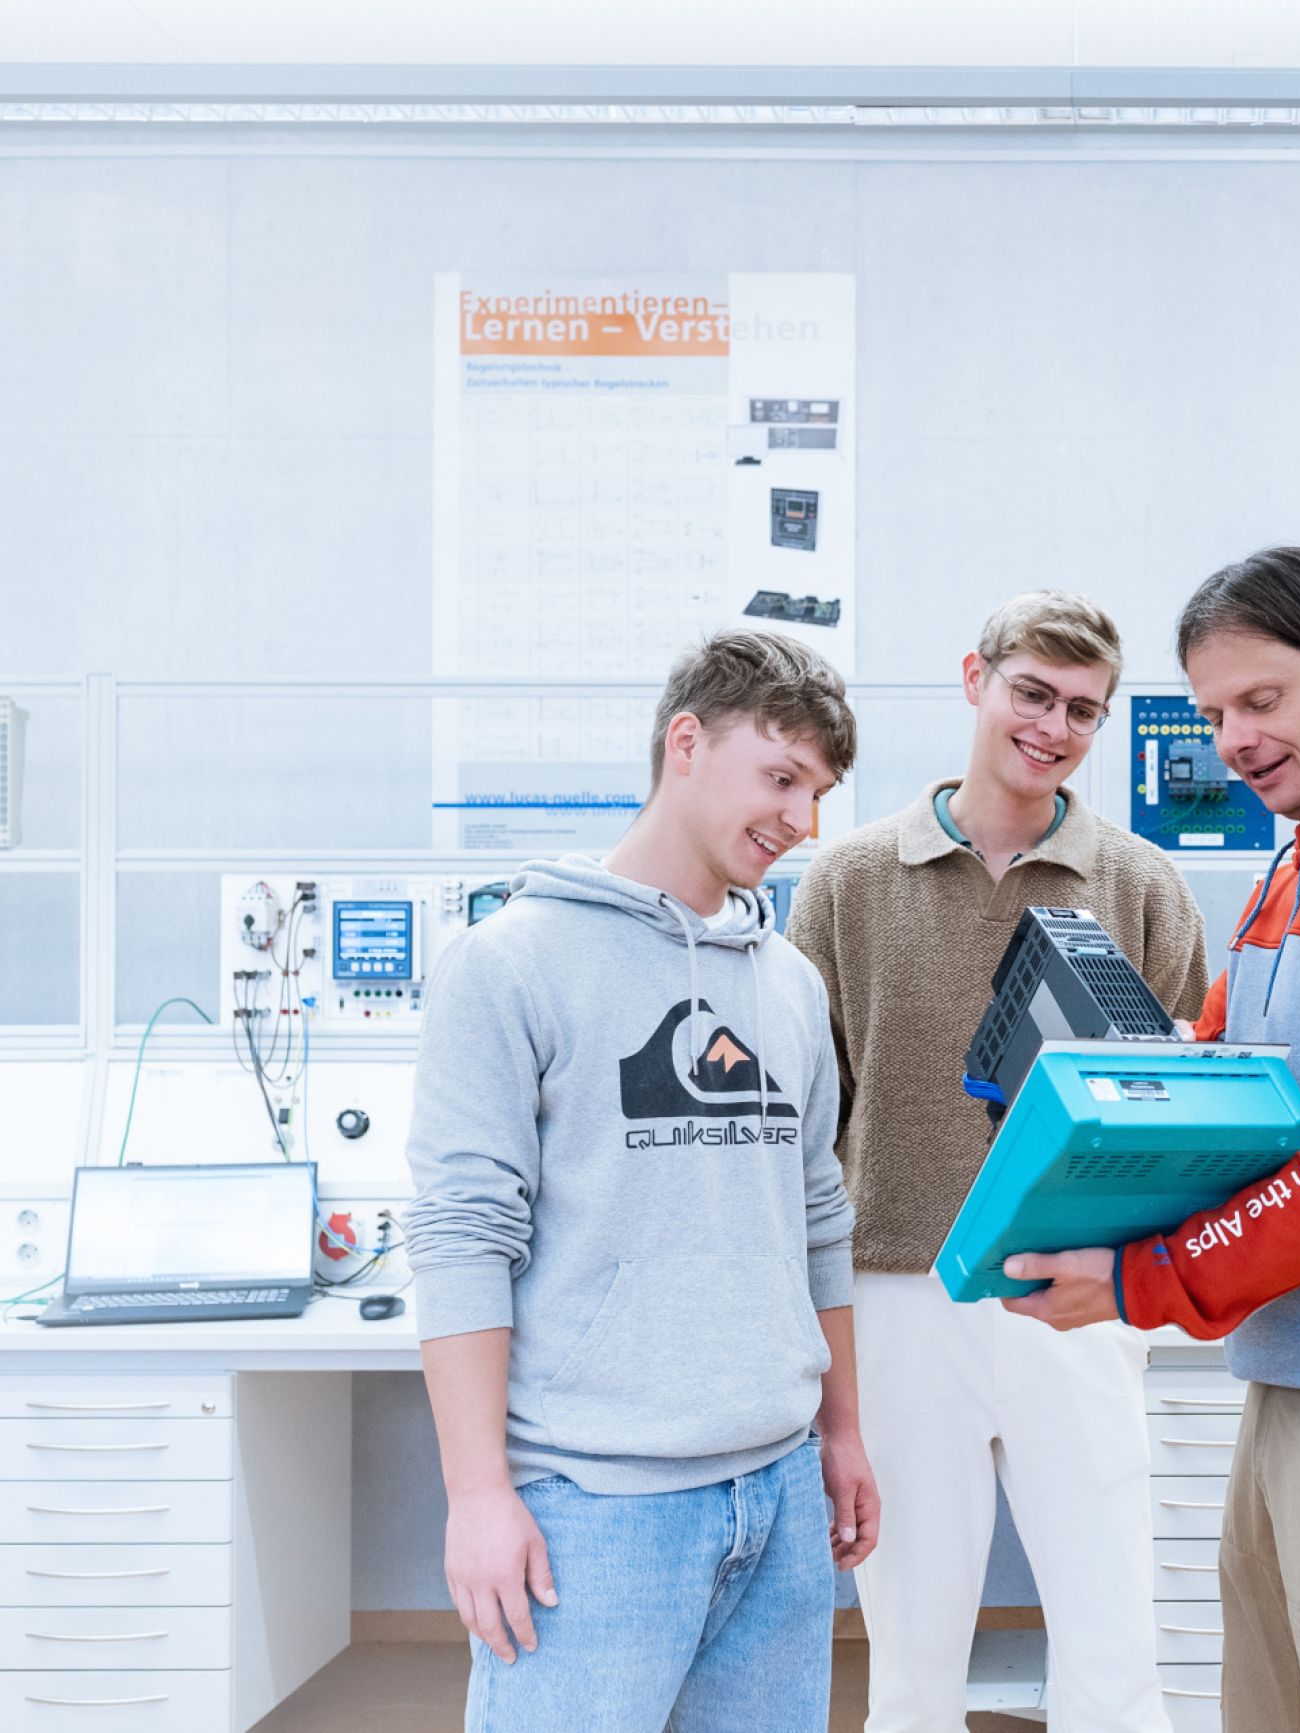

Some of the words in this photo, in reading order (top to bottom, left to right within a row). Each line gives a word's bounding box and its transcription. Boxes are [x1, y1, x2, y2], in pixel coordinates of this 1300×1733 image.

[466, 312, 589, 341] Lernen
[634, 312, 819, 341] Verstehen
[625, 1120, 798, 1149] QUIKSILVER
[1246, 1178, 1293, 1218] the
[1185, 1210, 1243, 1258] Alps
